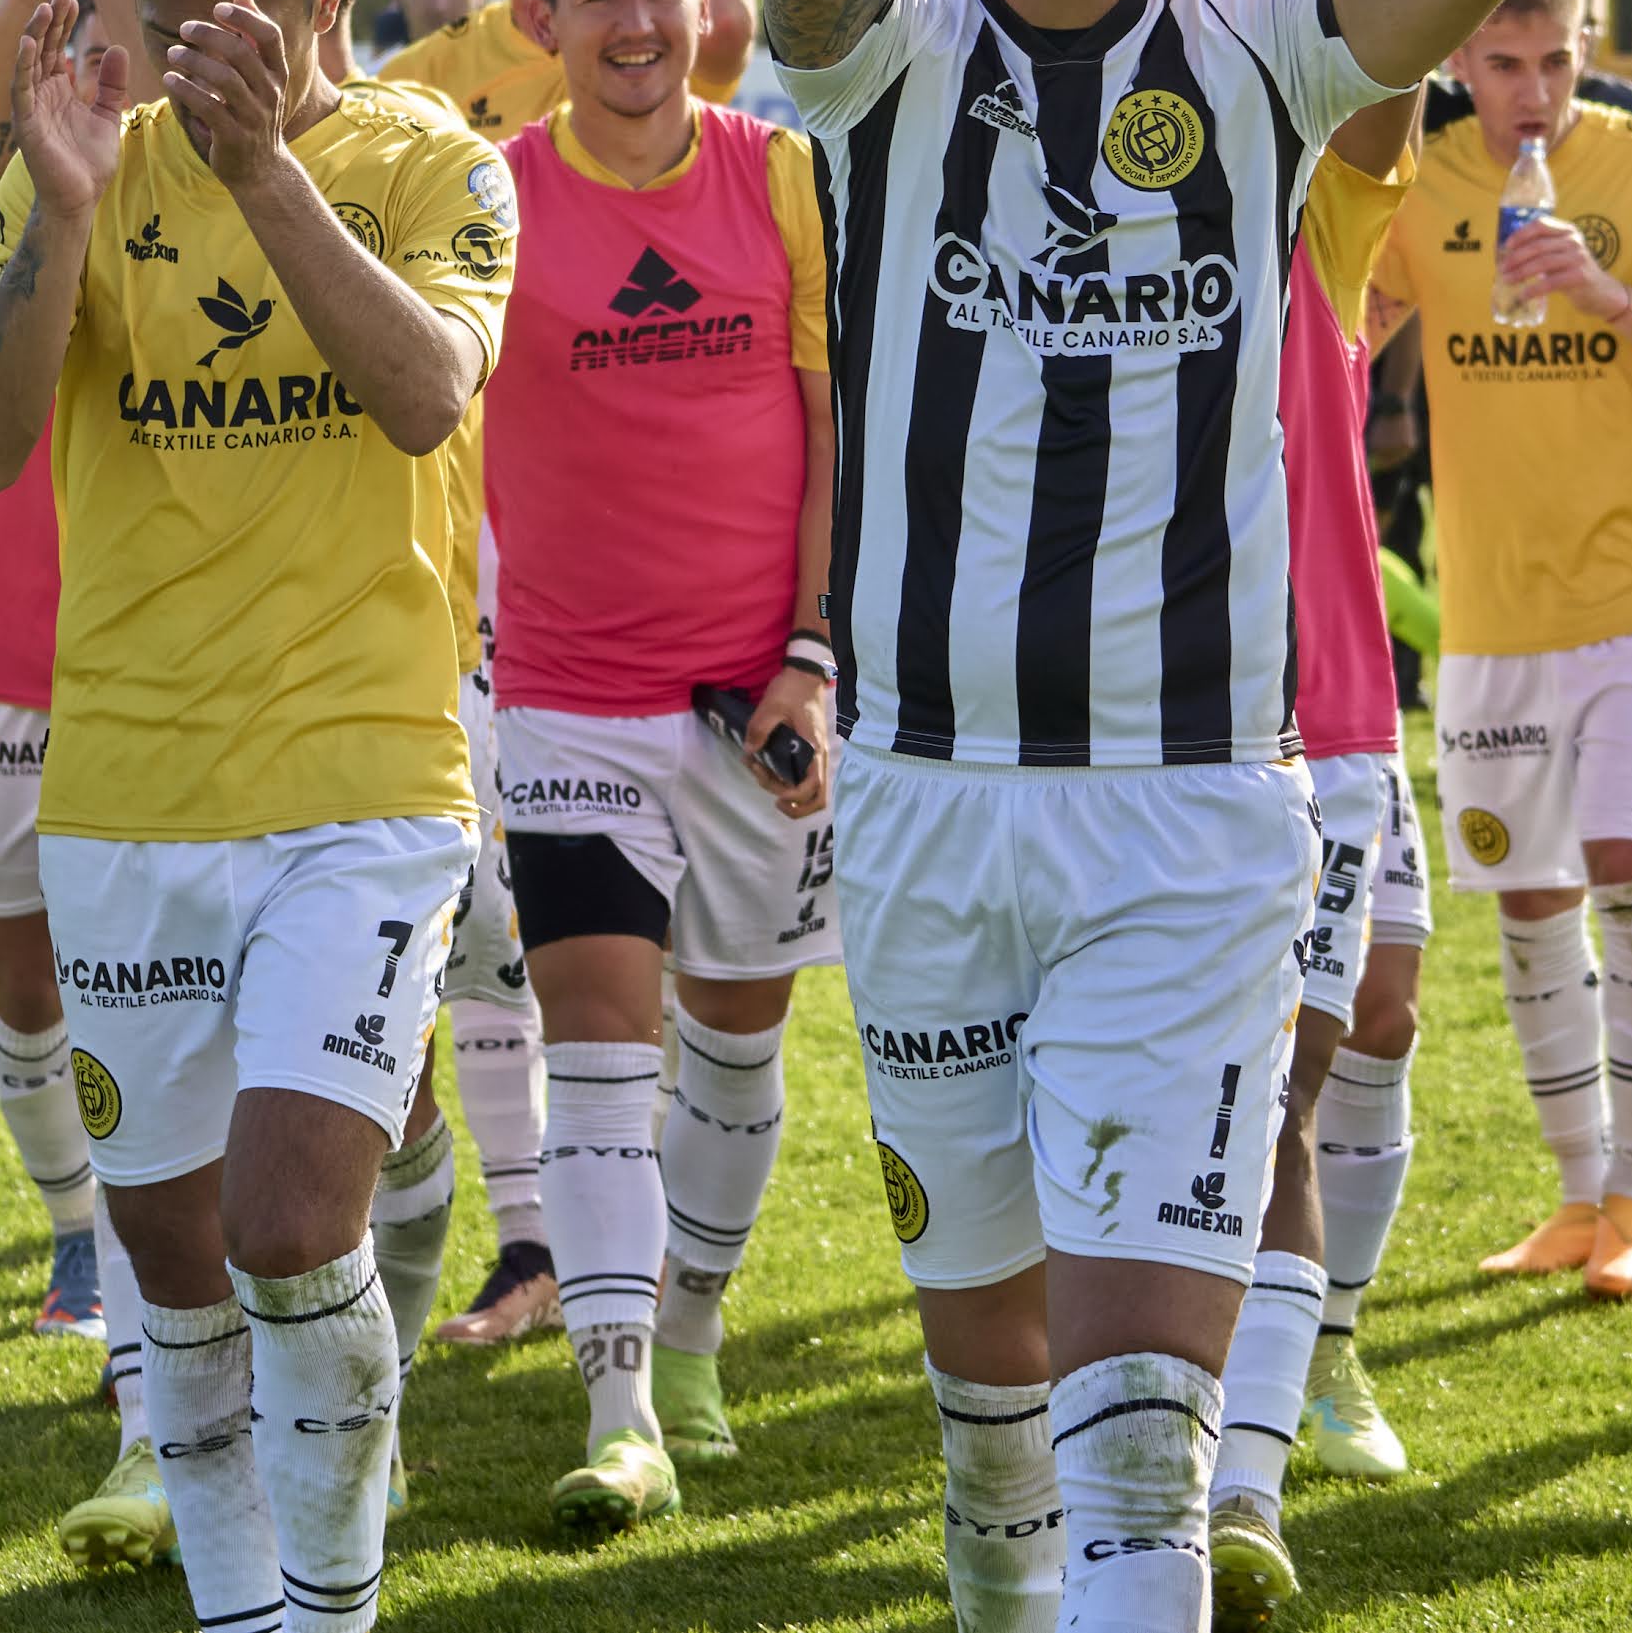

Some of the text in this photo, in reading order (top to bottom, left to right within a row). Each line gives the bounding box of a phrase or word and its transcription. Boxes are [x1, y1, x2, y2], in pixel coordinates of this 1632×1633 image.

[1120, 163, 1146, 183] SOCIAL
[1156, 151, 1193, 183] DEPORTIVO
[1180, 109, 1197, 151] FLANDRIA
[955, 303, 979, 323] AL
[1063, 328, 1170, 349] CANARIO
[1178, 325, 1215, 345] S.A.
[1447, 331, 1617, 367] CANARIO
[224, 426, 316, 450] CANARIO
[322, 423, 358, 440] S.A.
[1458, 724, 1548, 751] CANARIO
[511, 778, 641, 808] CANARIO
[72, 956, 225, 994] CANARIO
[377, 920, 414, 999] 7
[80, 989, 226, 1009] AL TEXTILE CANARIO SA
[322, 1033, 397, 1076] ANGEXIA
[888, 1064, 940, 1080] TEXTILE
[943, 1052, 1012, 1078] CANARIO
[1208, 1063, 1242, 1160] 1
[1158, 1201, 1243, 1238] ANGEXIA
